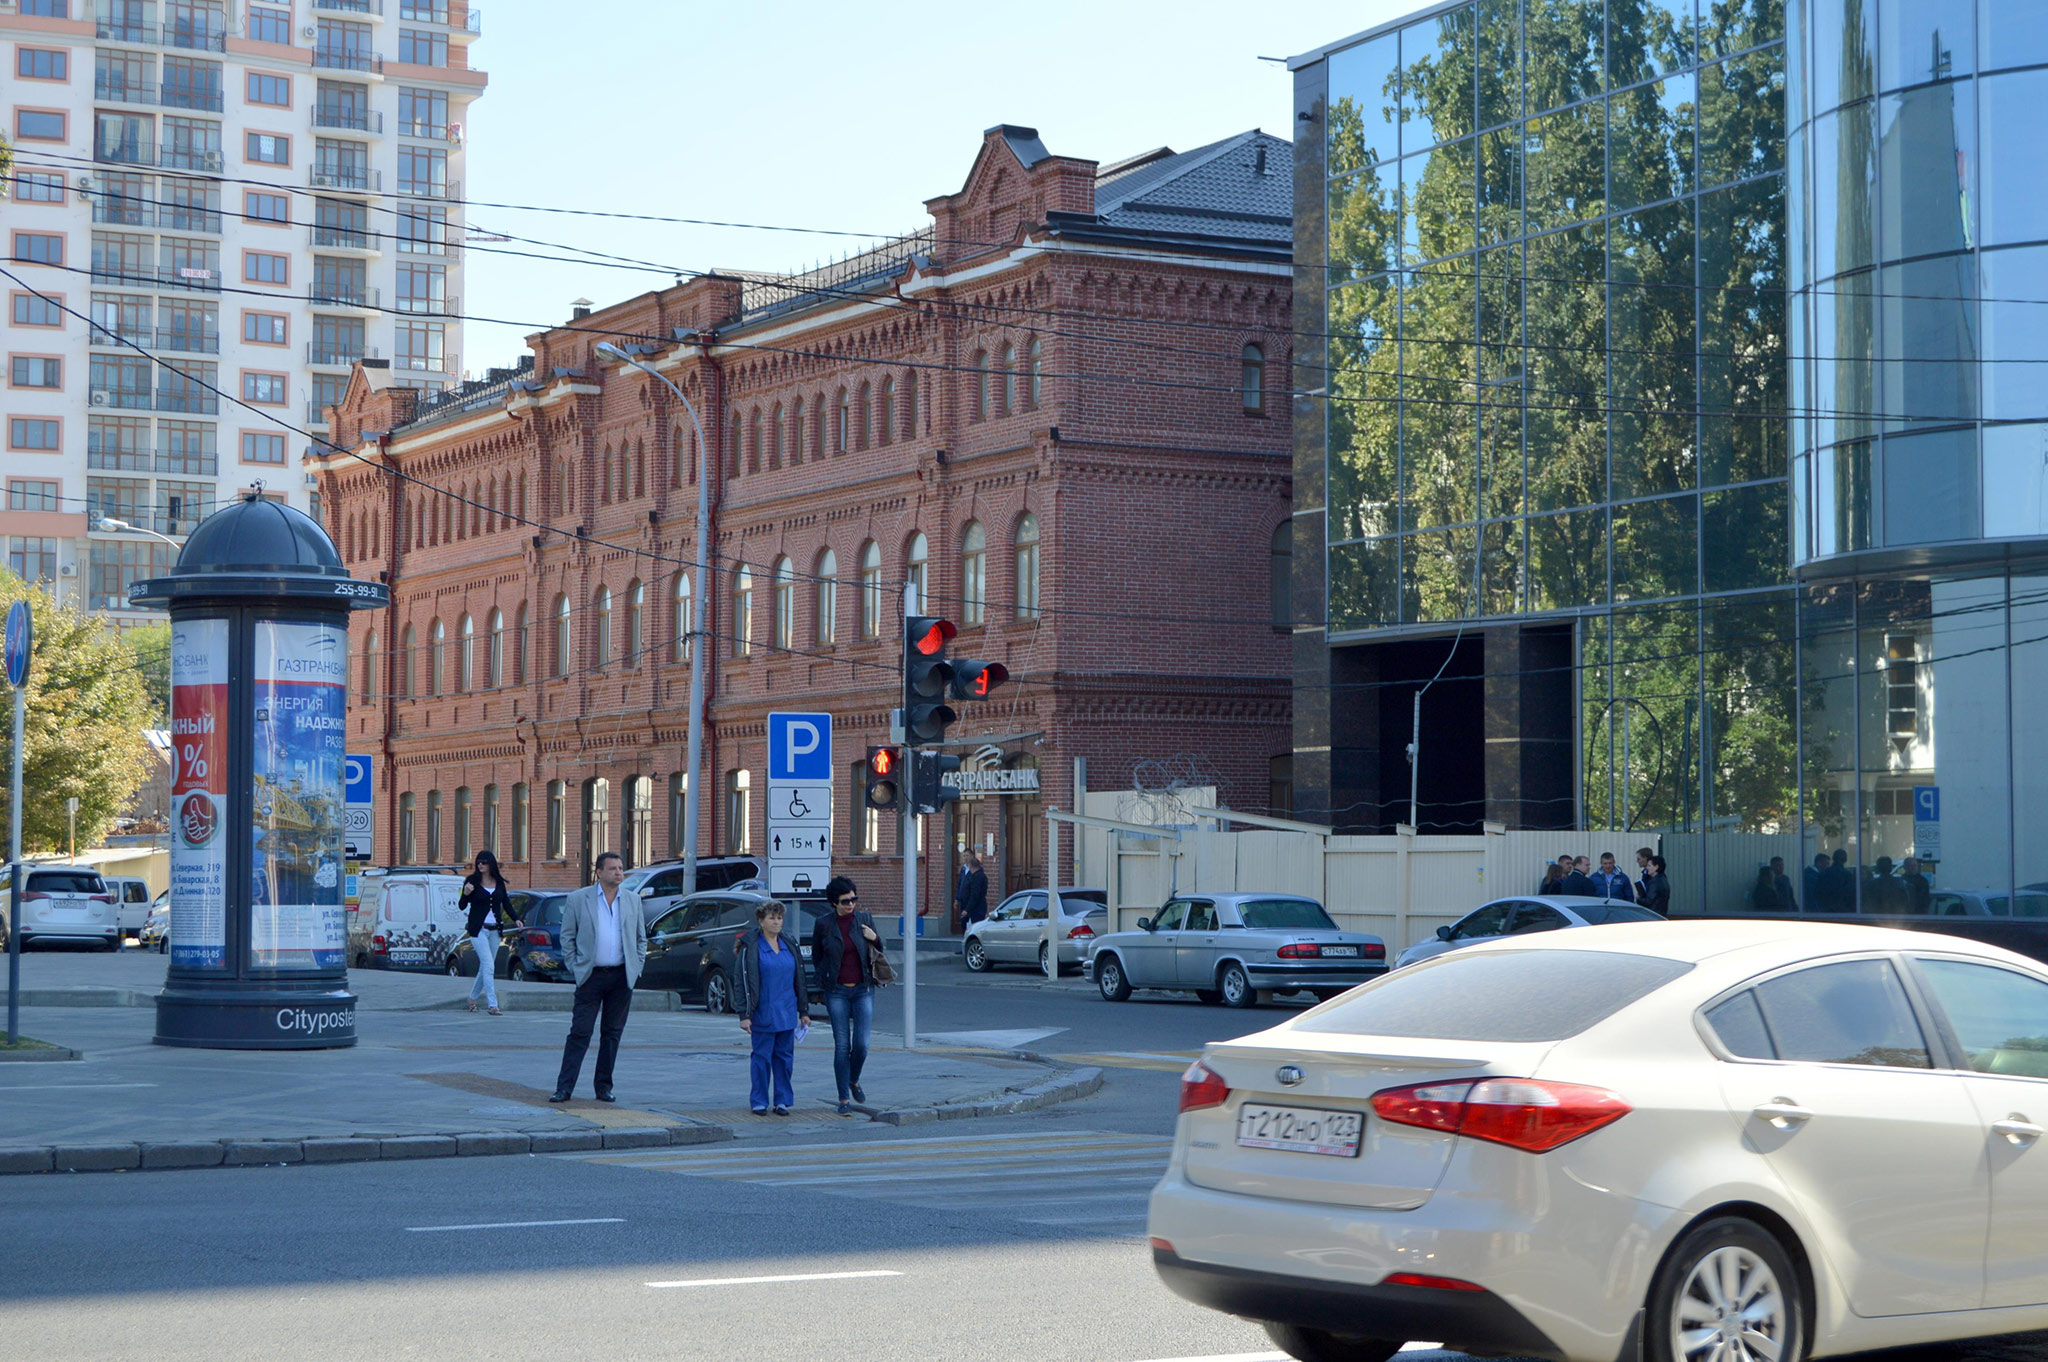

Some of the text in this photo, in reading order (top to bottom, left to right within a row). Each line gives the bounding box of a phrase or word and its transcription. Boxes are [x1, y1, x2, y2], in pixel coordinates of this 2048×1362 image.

[334, 583, 378, 598] 255-99-91
[787, 721, 820, 773] P
[941, 769, 1040, 790] ГАЗТРАНСБАНК
[353, 815, 365, 825] 20
[790, 837, 802, 849] 15
[206, 863, 221, 872] 319
[214, 874, 220, 884] 8
